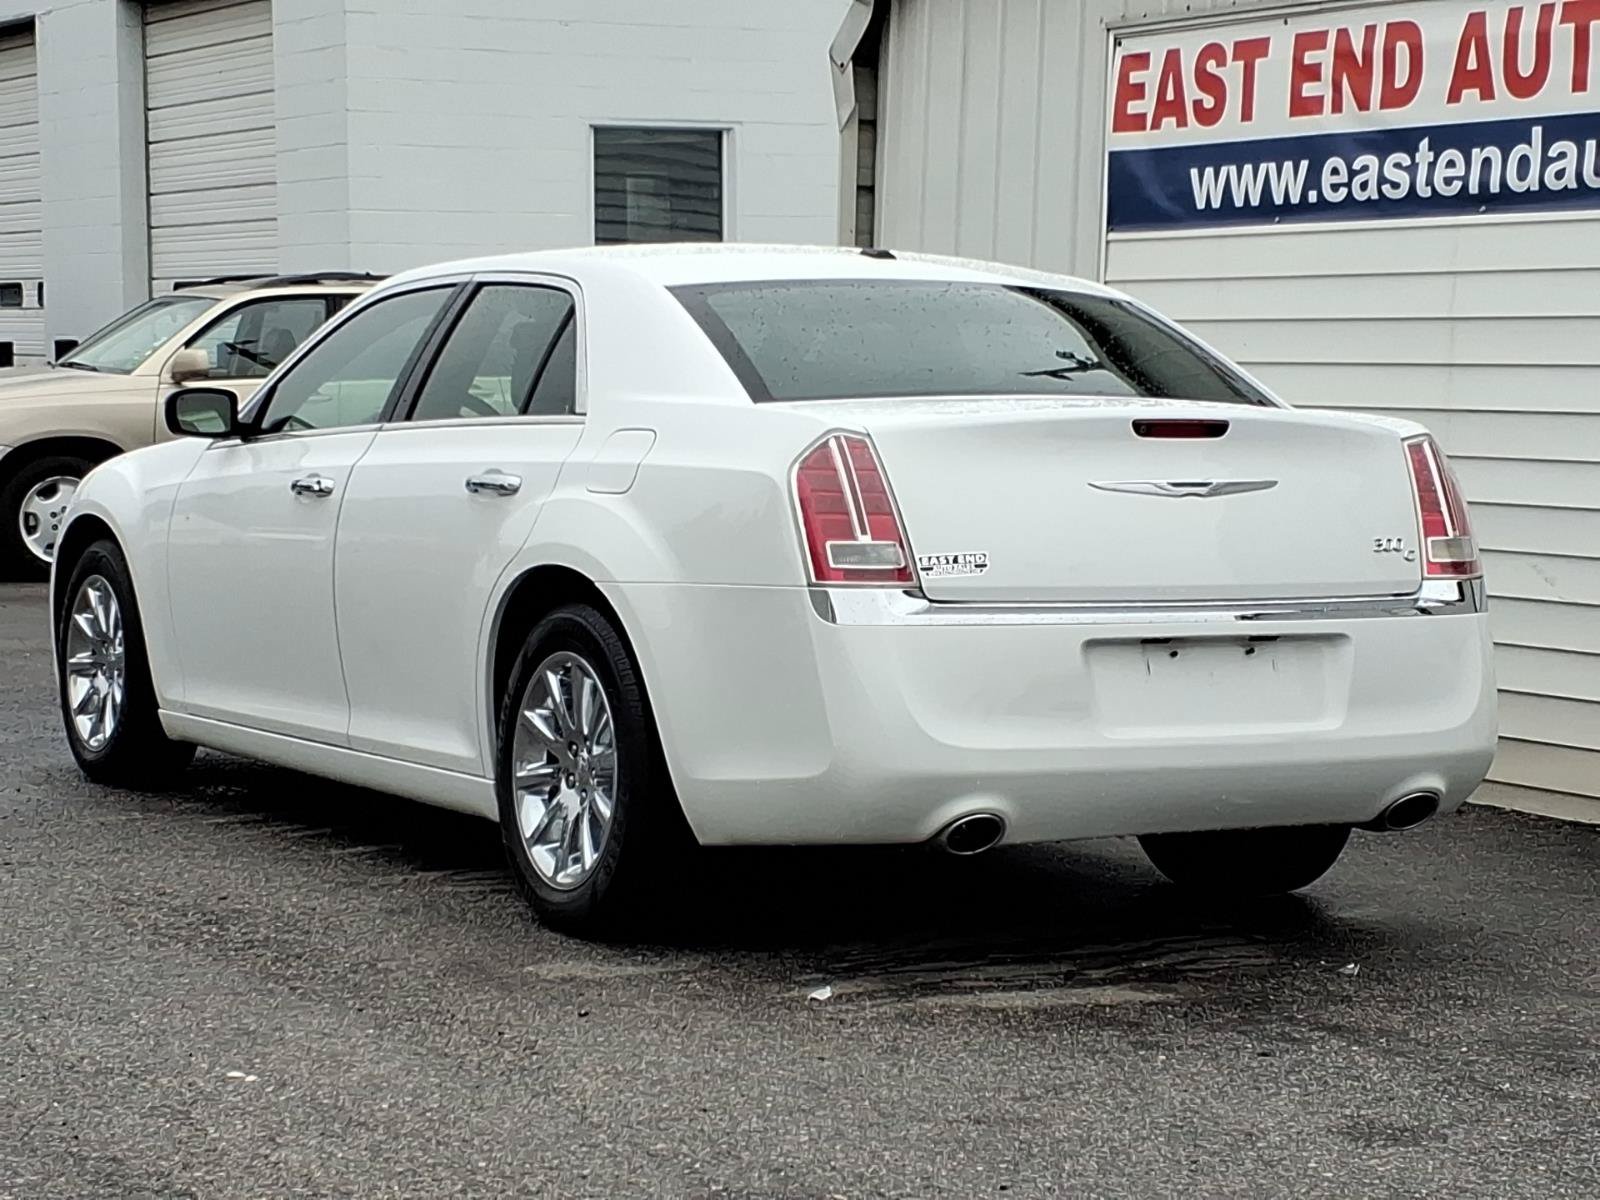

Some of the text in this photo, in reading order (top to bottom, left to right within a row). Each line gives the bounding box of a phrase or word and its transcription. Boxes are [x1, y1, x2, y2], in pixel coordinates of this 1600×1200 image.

[1111, 36, 1271, 133] EAST
[1289, 20, 1425, 119] END
[920, 553, 986, 566] EAST END
